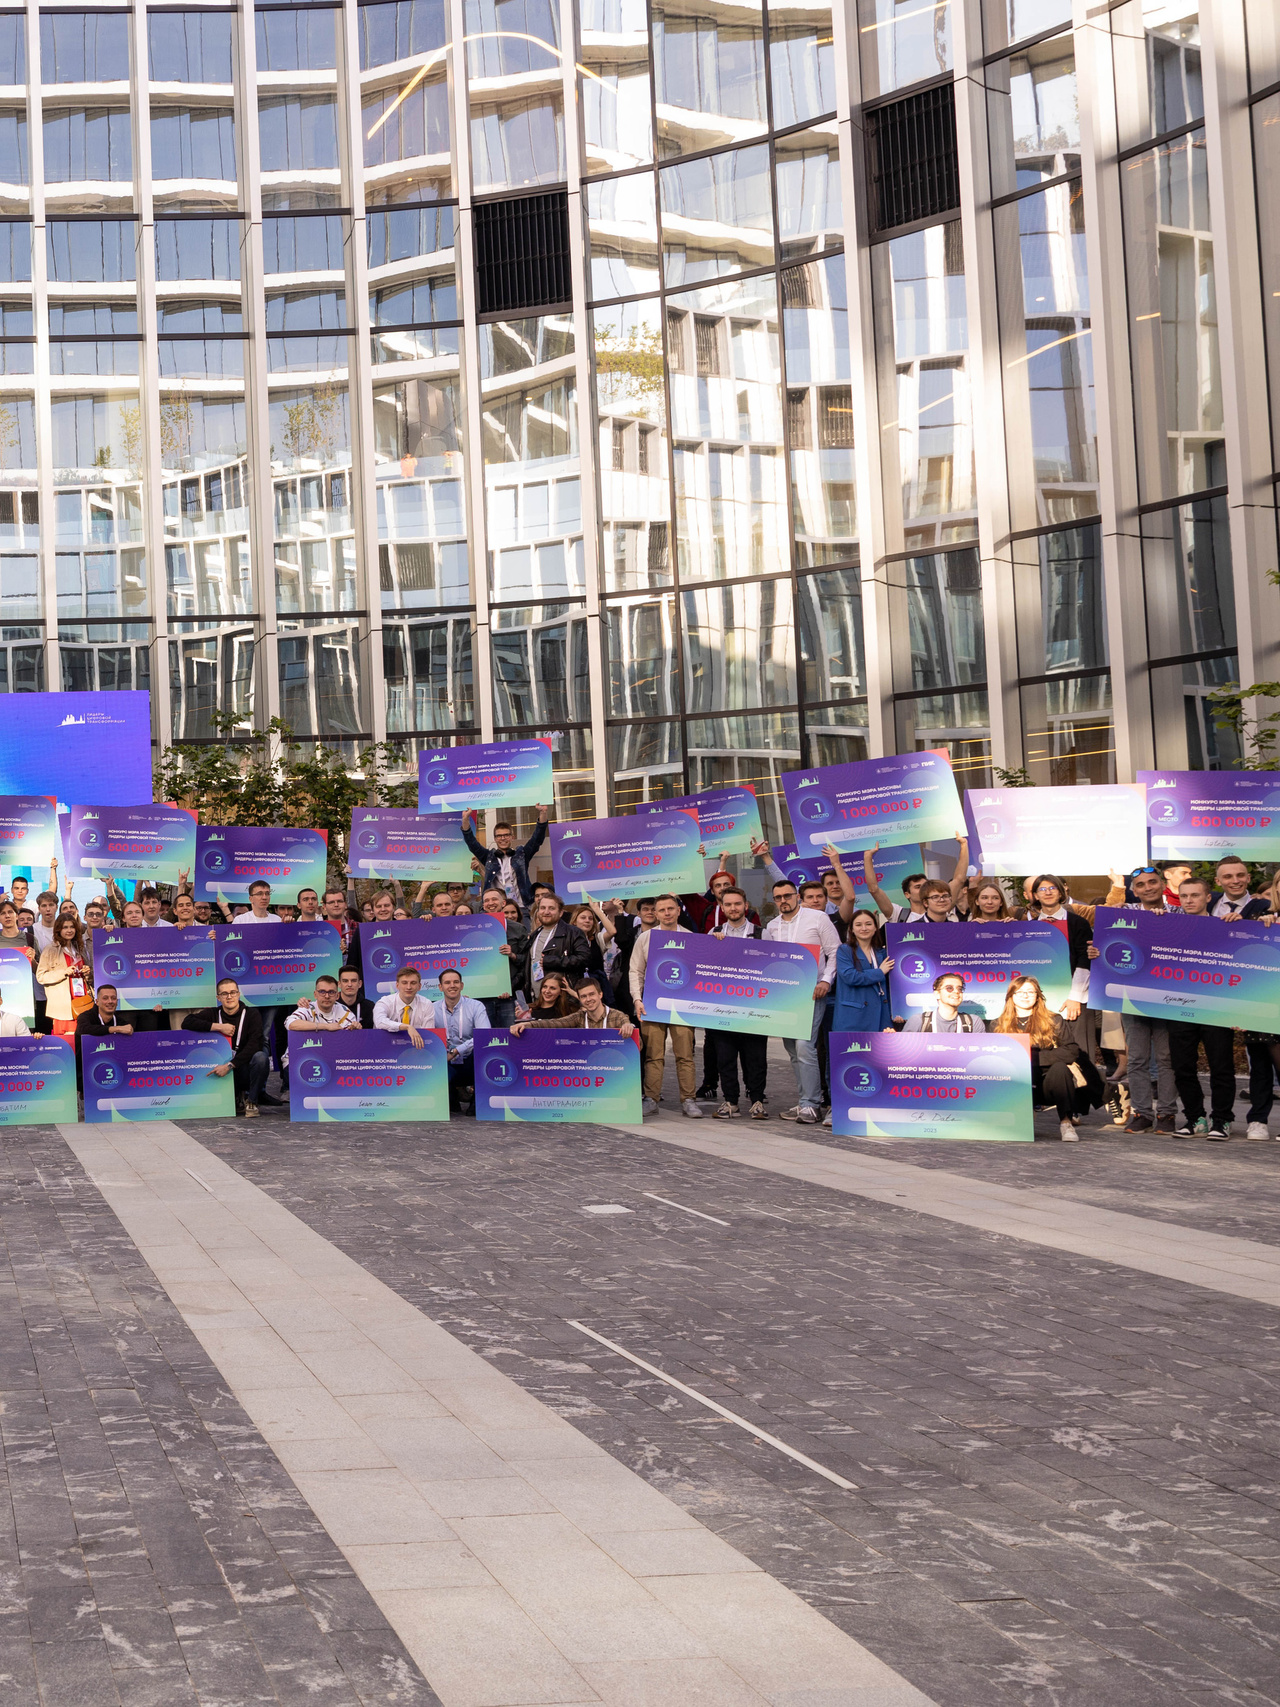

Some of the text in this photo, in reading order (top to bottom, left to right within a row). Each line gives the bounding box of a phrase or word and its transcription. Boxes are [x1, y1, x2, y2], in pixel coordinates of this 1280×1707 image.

[458, 778, 480, 787] 400
[483, 775, 505, 784] 000
[814, 802, 822, 812] 1
[840, 797, 924, 819] 1 000 000 ₽
[1191, 817, 1271, 827] 600 000 ₽
[108, 843, 163, 854] 600 000 ₽
[597, 855, 662, 871] 400 000 ₽
[790, 953, 804, 961] ПИК
[1121, 949, 1132, 962] 3
[1152, 945, 1182, 954] КОНКУРС
[1203, 951, 1233, 959] МОСКВЫ
[1151, 953, 1280, 973] ЛИДЕРЫ ЦИФРОВОЙ ТРАНСФОРМАЦИИ
[671, 967, 680, 979] 3
[719, 972, 749, 980] ЦИФРОВОЙ
[749, 976, 799, 986] ТРАНСФОРМАЦИИ
[1150, 965, 1242, 987] 400 000 ₽
[694, 981, 769, 999] 400 000 ₽
[499, 1065, 505, 1075] 1
[128, 1075, 194, 1088] 400 000 ₽
[336, 1075, 405, 1086] 400 000 ₽
[523, 1076, 605, 1087] 1 000 000 ₽
[859, 1072, 869, 1084] 3
[8, 1081, 33, 1092] 000
[36, 1080, 45, 1091] ₽
[888, 1085, 977, 1099] 400 000 ₽
